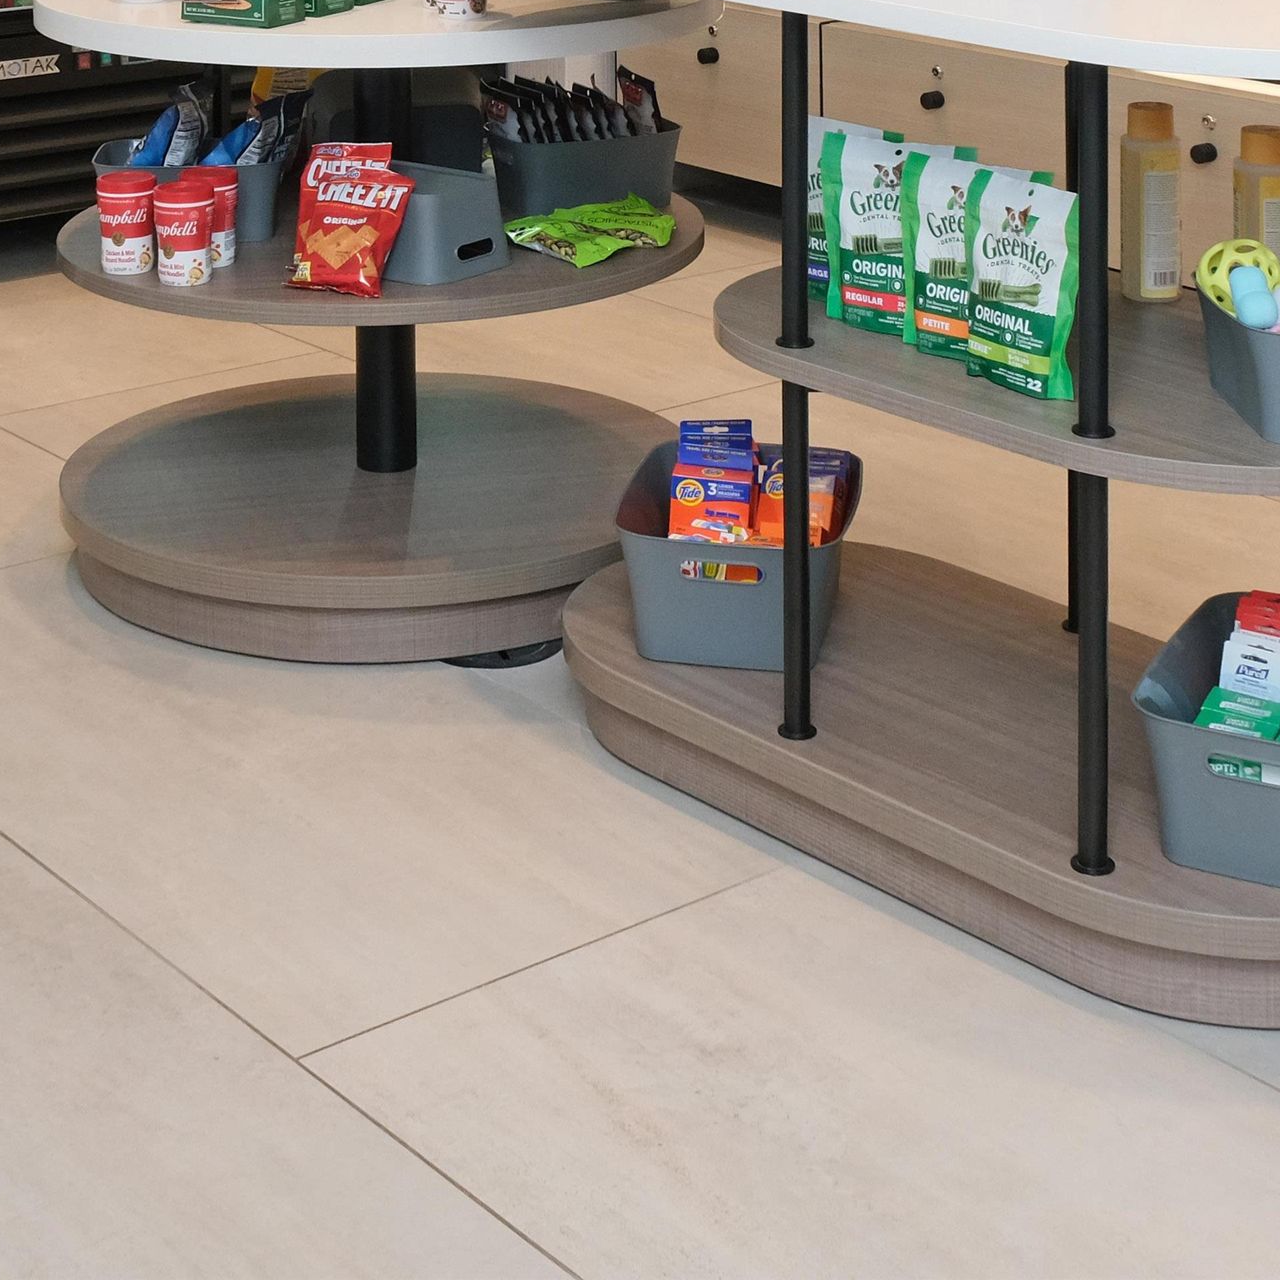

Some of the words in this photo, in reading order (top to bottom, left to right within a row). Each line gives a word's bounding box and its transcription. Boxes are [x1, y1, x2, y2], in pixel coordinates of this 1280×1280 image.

[317, 182, 408, 211] CHEEZ-IT
[981, 233, 1055, 275] Greenies
[808, 267, 829, 278] ARGE
[988, 259, 1014, 268] DENTAL
[1018, 261, 1041, 283] TREATS
[845, 292, 884, 306] REGULAR
[922, 317, 950, 331] PETITE
[975, 304, 1033, 336] ORIGINAL
[1026, 378, 1042, 393] 22
[680, 485, 702, 499] Tide
[707, 482, 718, 496] 3
[1239, 666, 1267, 679] Purell
